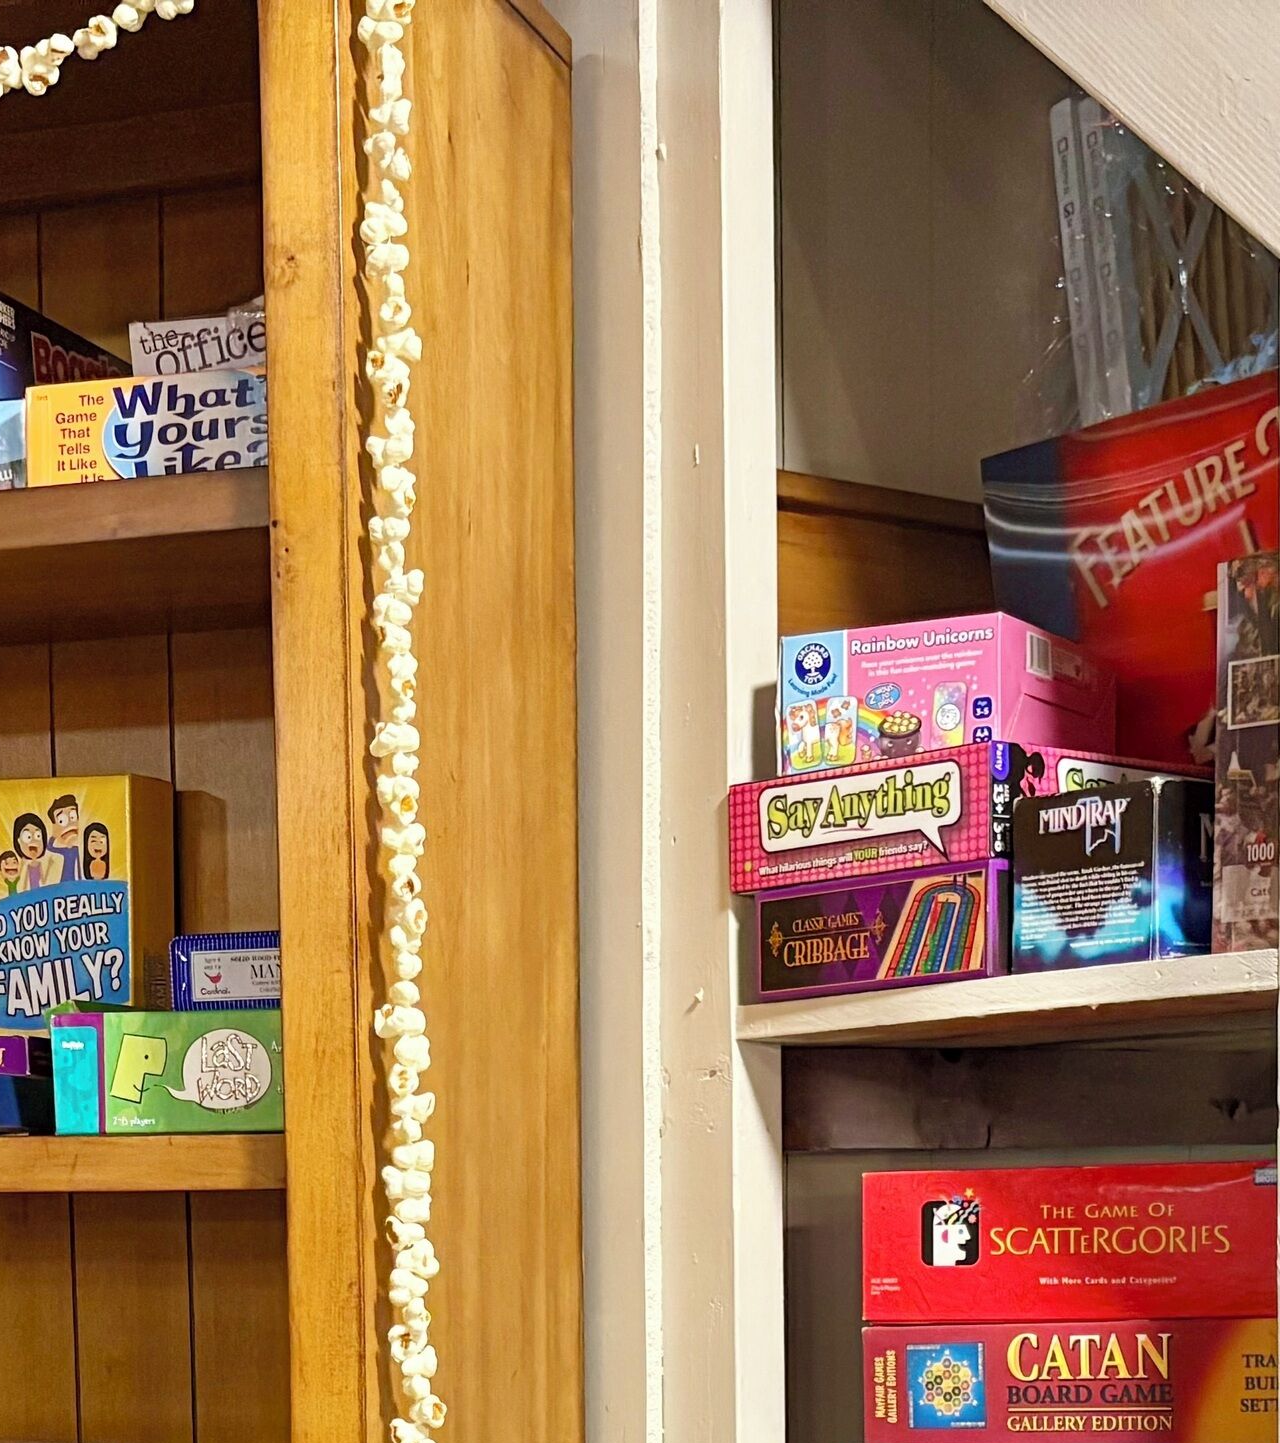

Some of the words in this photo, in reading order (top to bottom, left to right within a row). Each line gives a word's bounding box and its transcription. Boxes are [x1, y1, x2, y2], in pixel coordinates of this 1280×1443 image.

[1069, 440, 1256, 609] FEATURE
[851, 639, 919, 655] Rainbow
[923, 628, 994, 646] Unicorns
[768, 795, 820, 840] Say
[821, 770, 951, 829] Anything
[1039, 797, 1130, 856] MINDTRAP
[759, 867, 777, 876] What
[779, 861, 811, 873] hilarious
[813, 857, 836, 869] things
[838, 853, 853, 864] will
[854, 848, 877, 861] YOUR
[879, 845, 906, 858] friends
[907, 841, 928, 854] say?
[1247, 843, 1274, 862] 1000
[10, 904, 48, 935] YOU
[54, 892, 122, 924] REALLY
[56, 921, 108, 956] YOUR
[784, 933, 869, 967] CRIBBAGE
[1007, 1333, 1173, 1382] CATAN
[1007, 1384, 1091, 1406] BOARD
[1101, 1383, 1173, 1404] GAME
[1007, 1415, 1086, 1432] GALLERY
[1091, 1415, 1173, 1432] EDITION
